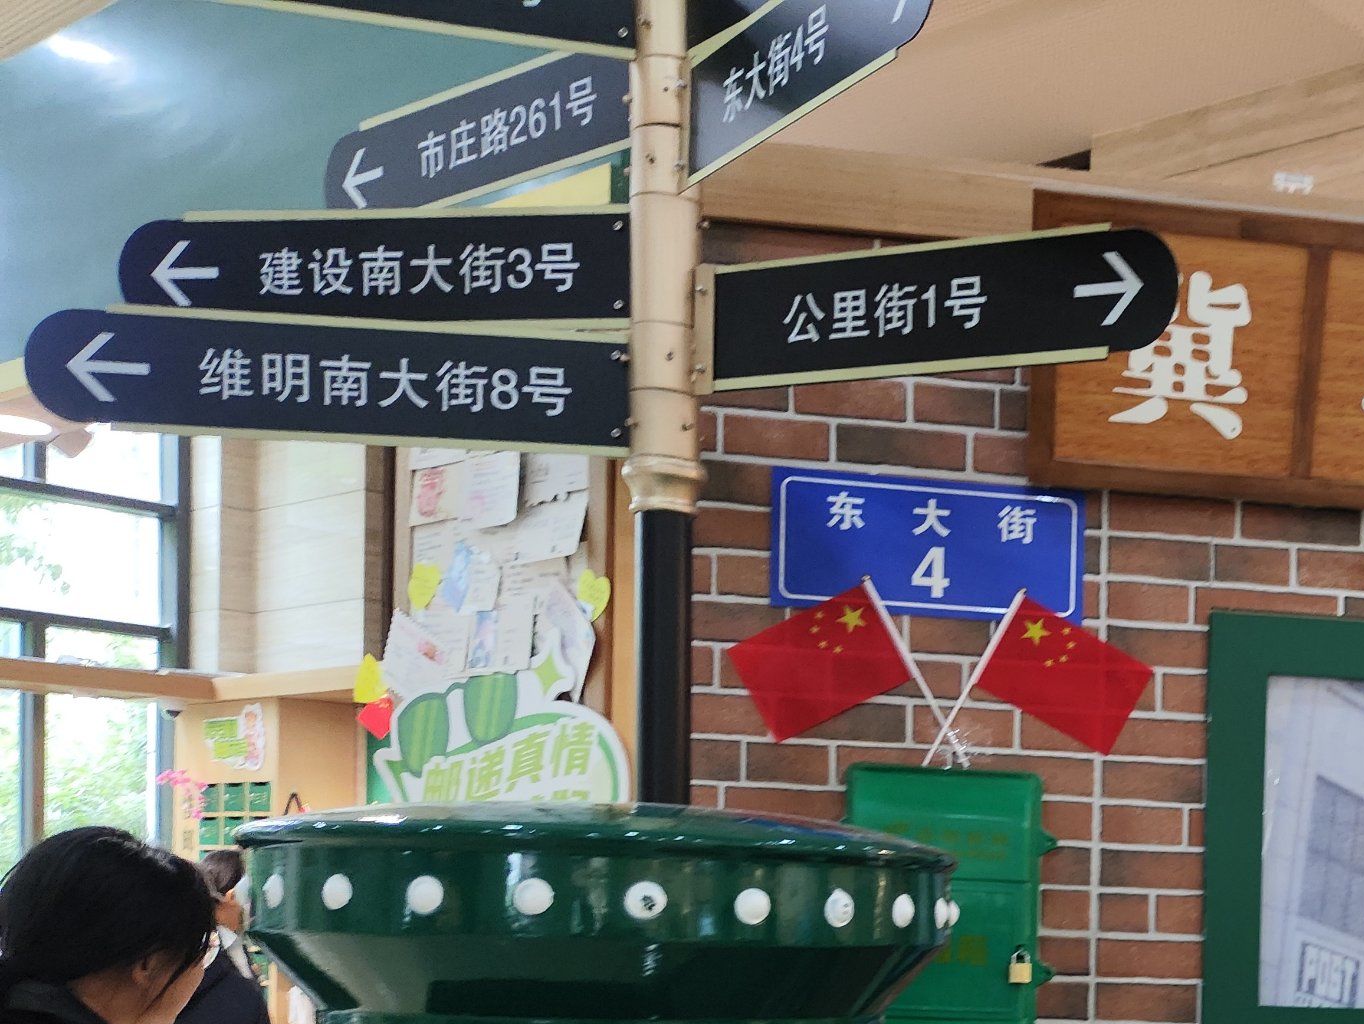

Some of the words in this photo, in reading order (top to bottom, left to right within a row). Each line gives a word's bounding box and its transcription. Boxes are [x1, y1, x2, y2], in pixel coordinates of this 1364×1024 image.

[721, 4, 830, 123] 东大街4号
[417, 76, 598, 179] 市庄路261号
[258, 242, 581, 297] 建设南大街3号
[782, 276, 988, 344] 公里街1号
[198, 348, 573, 417] 维明南大街8号
[826, 490, 1037, 545] 东大街
[911, 546, 950, 599] 4
[423, 721, 597, 803] 邮递真情
